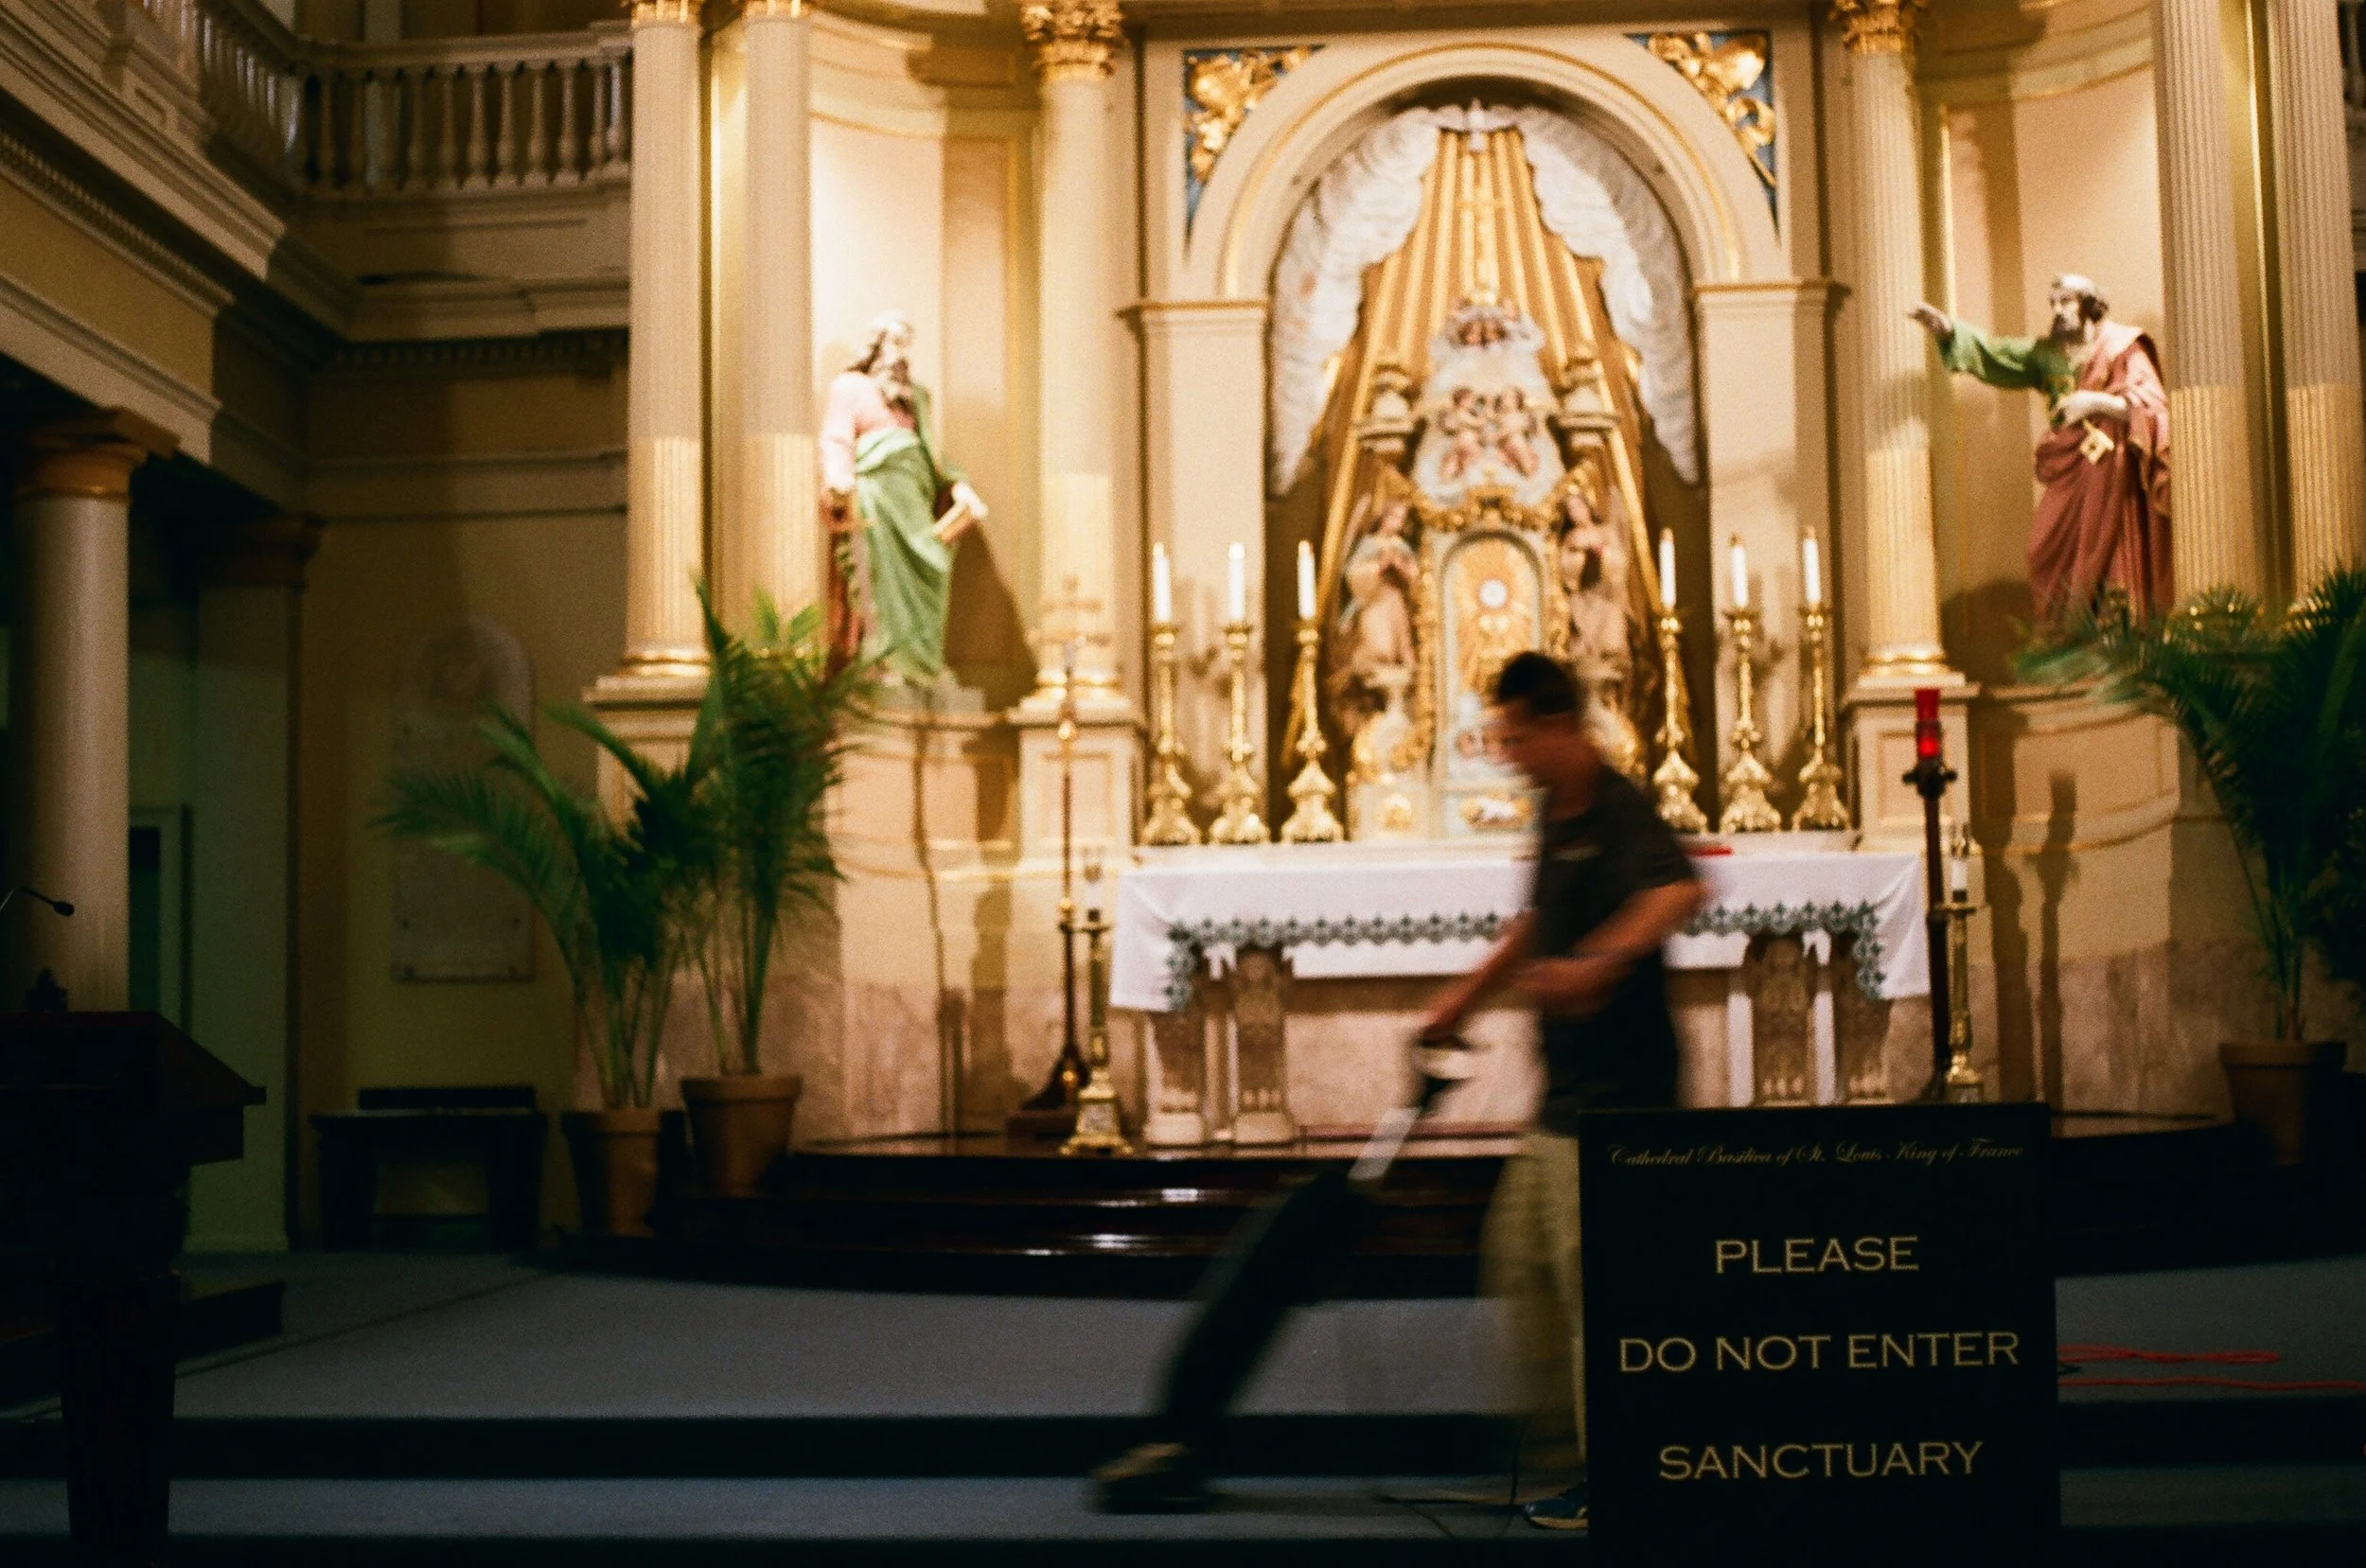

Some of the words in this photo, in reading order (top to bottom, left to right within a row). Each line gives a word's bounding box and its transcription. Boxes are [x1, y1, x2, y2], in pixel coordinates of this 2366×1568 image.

[1607, 1142, 1697, 1165] Cathedral
[1696, 1143, 1773, 1165] Basilica
[1774, 1146, 1795, 1168] of
[1795, 1141, 1826, 1165] St.
[1886, 1140, 1939, 1168] King
[1941, 1142, 1962, 1165] of
[1961, 1137, 2025, 1160] France
[1715, 1235, 1919, 1274] PLEASE
[1619, 1336, 1697, 1372] DO
[1715, 1334, 1831, 1371] NOT
[1847, 1331, 2019, 1368] ENTER
[1659, 1441, 1983, 1481] SANCTUARY
